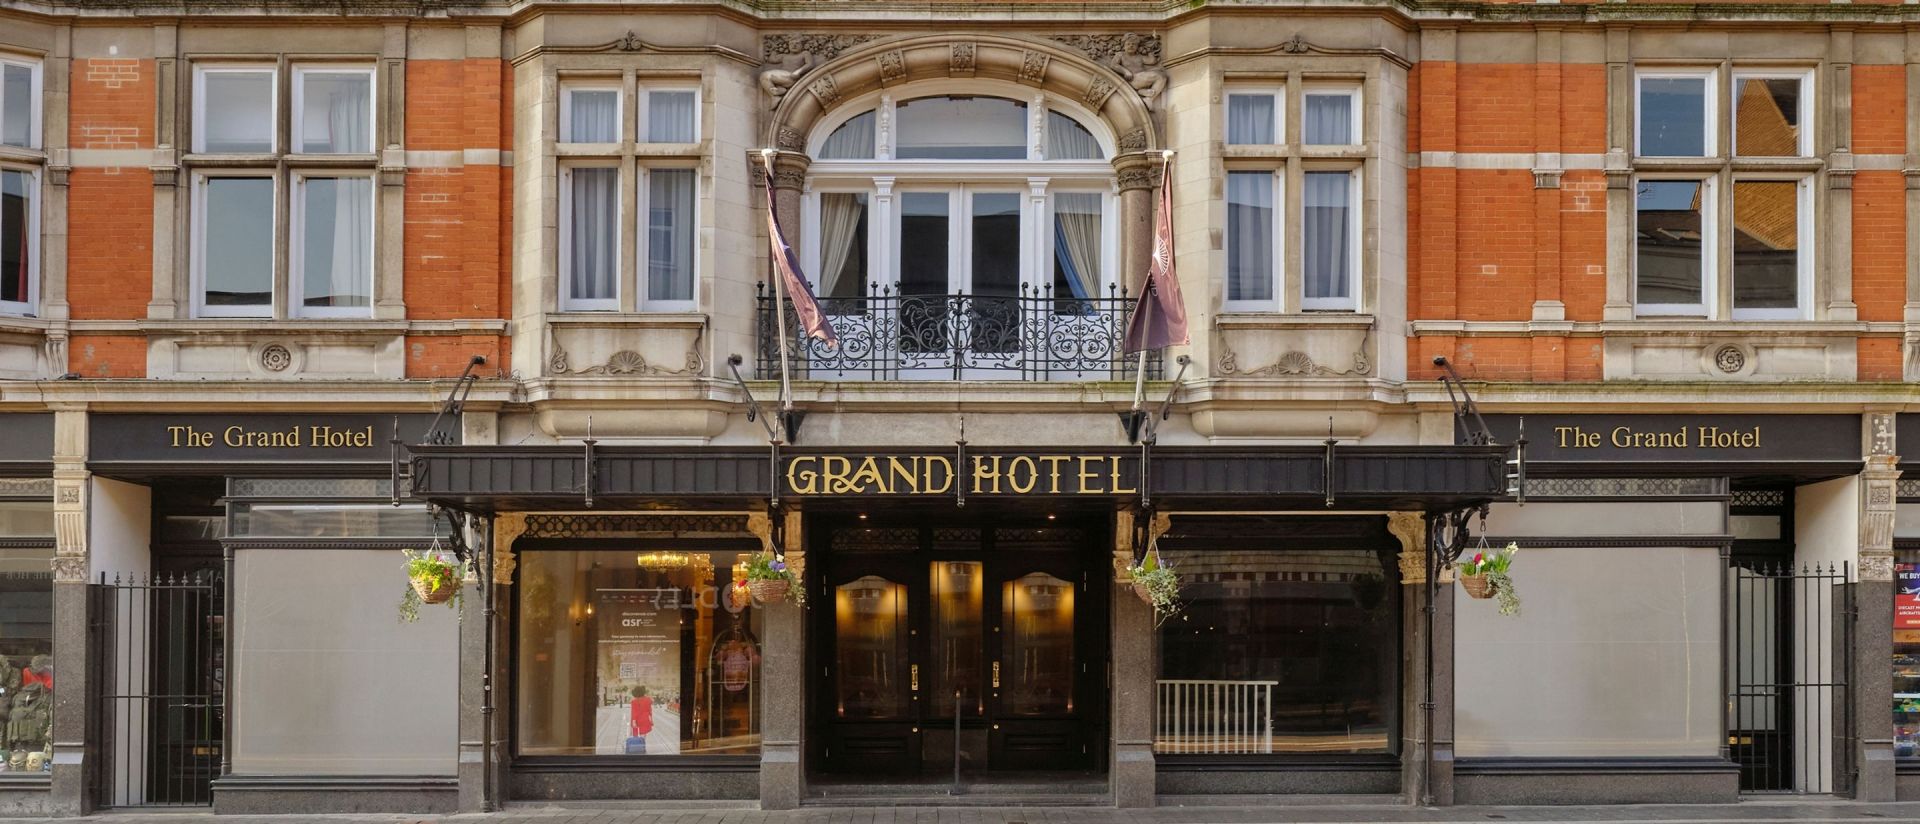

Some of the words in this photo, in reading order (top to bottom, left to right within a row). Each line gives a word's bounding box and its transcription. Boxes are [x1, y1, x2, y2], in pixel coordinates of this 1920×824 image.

[167, 425, 214, 448] The
[224, 425, 301, 448] Grand
[310, 425, 374, 448] Hotel
[1554, 426, 1601, 448] The
[1611, 426, 1688, 448] Grand
[1697, 426, 1761, 448] Hotel
[785, 455, 955, 494] GRAND
[971, 455, 1137, 494] HOTEL
[1899, 572, 1909, 580] WE
[622, 618, 642, 627] asr
